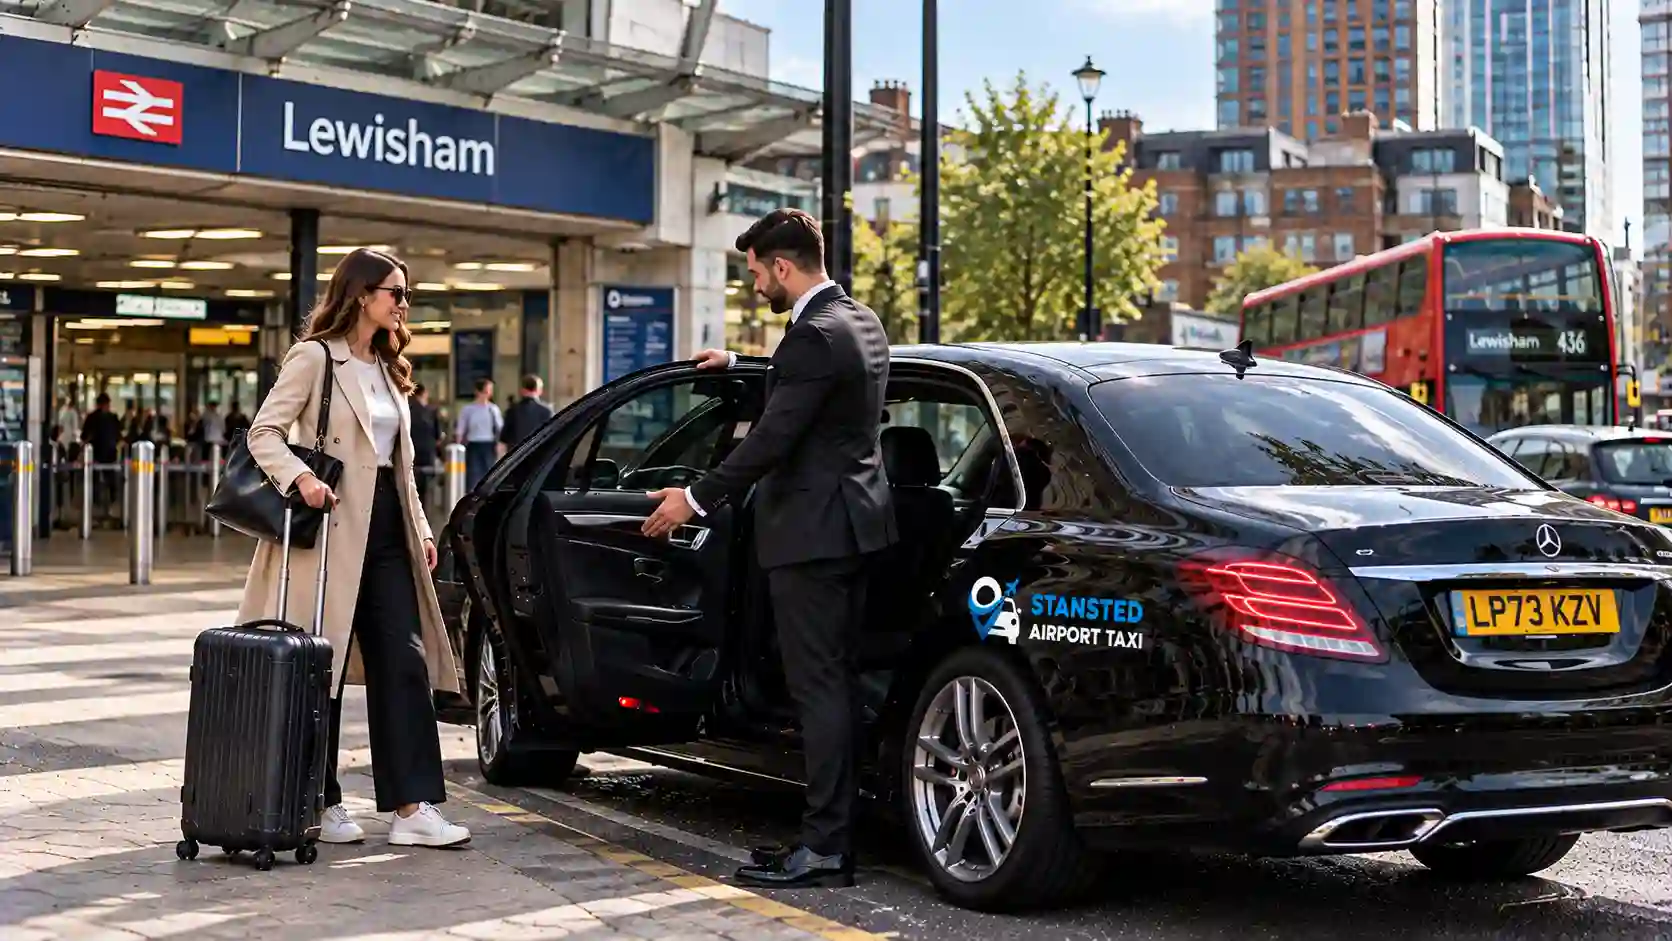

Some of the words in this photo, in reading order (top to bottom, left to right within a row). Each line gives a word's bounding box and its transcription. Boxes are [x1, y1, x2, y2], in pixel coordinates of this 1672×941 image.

[284, 101, 494, 175] Lewisham
[1469, 332, 1540, 349] Lewisham
[1557, 330, 1586, 354] 436
[1031, 593, 1144, 623] STANSTED
[1469, 595, 1544, 627] LP73
[1550, 594, 1601, 626] KZV
[1028, 623, 1101, 645] AIRPORT
[1106, 629, 1143, 649] TAXI
